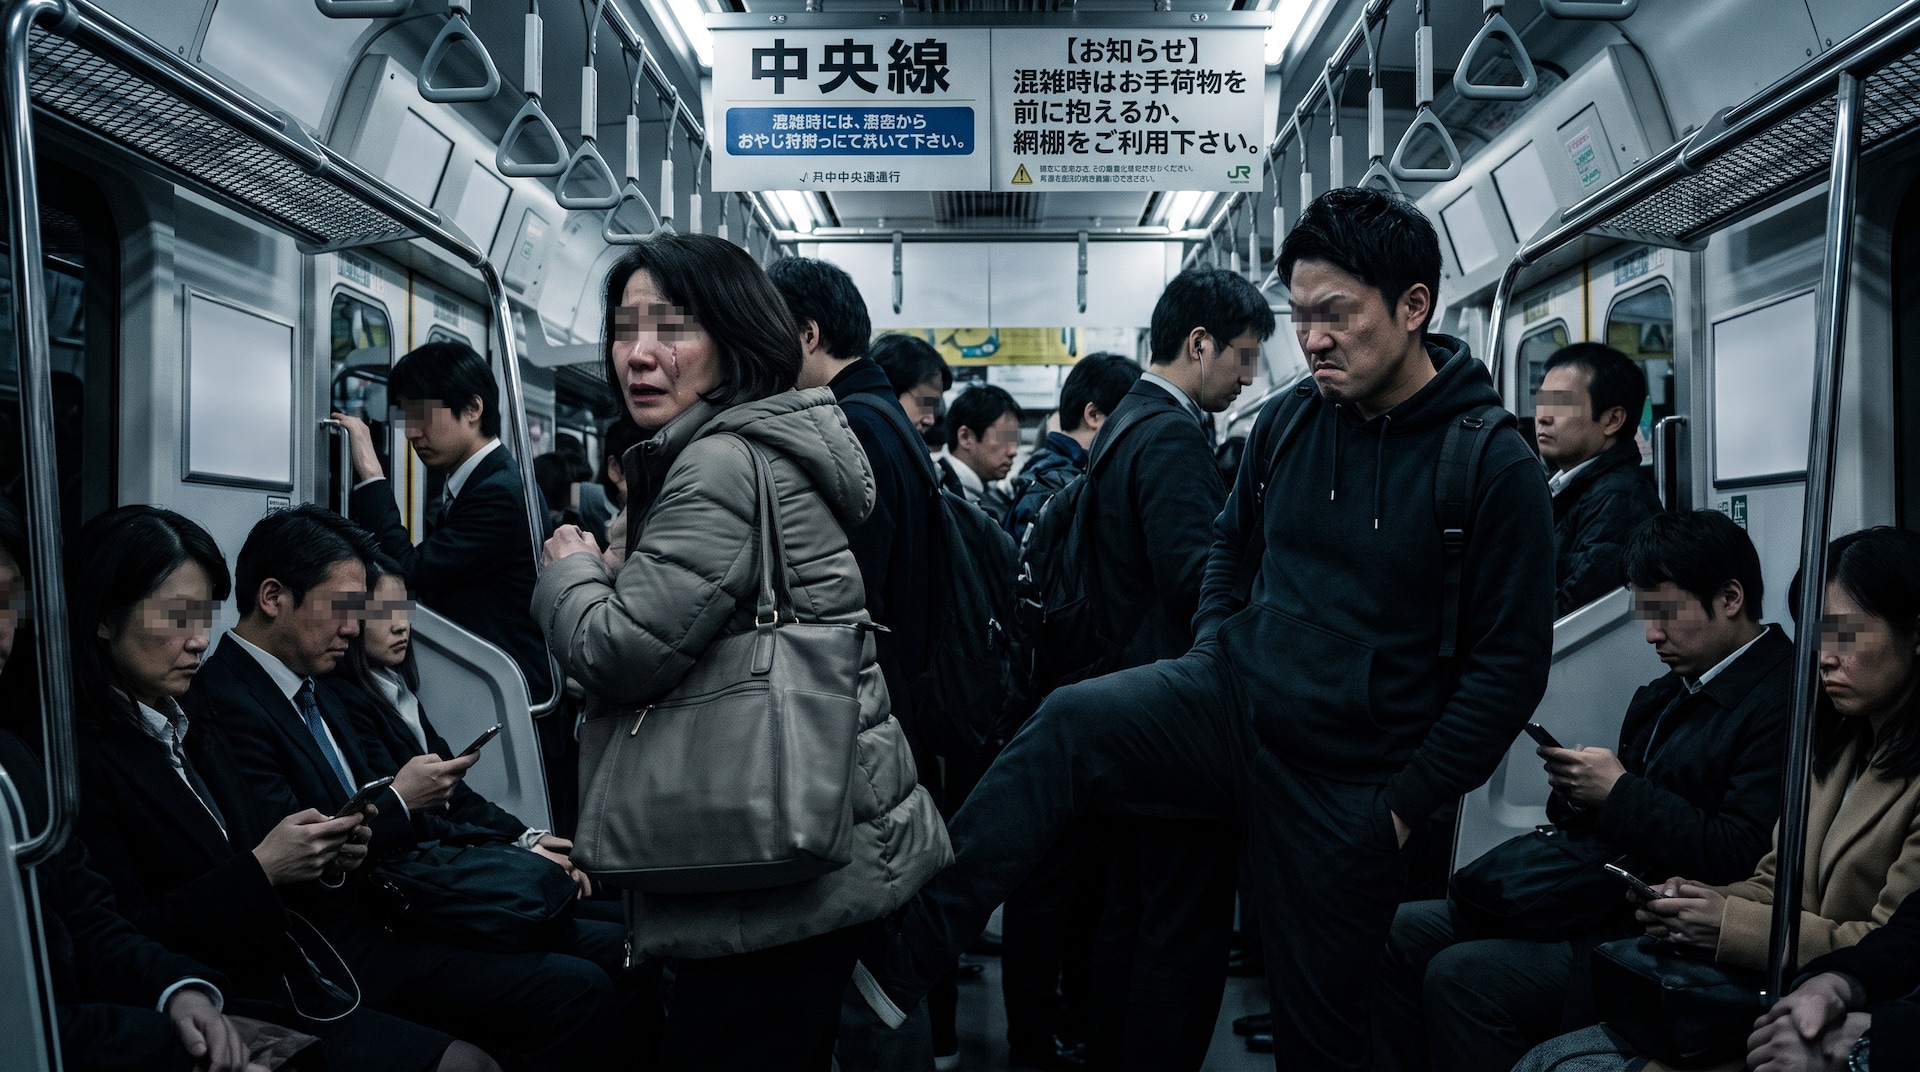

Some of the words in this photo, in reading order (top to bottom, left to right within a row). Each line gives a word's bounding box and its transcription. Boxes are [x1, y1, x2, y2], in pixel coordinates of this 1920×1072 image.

[1067, 37, 1198, 64] 【お知らせ】
[751, 38, 951, 95] 中央線
[1013, 68, 1247, 95] 混雑時はお手荷物を
[1013, 98, 1180, 125] 前に抱えるか、
[1012, 129, 1258, 155] 網棚をご利用下さい。
[1227, 166, 1251, 179] JR
